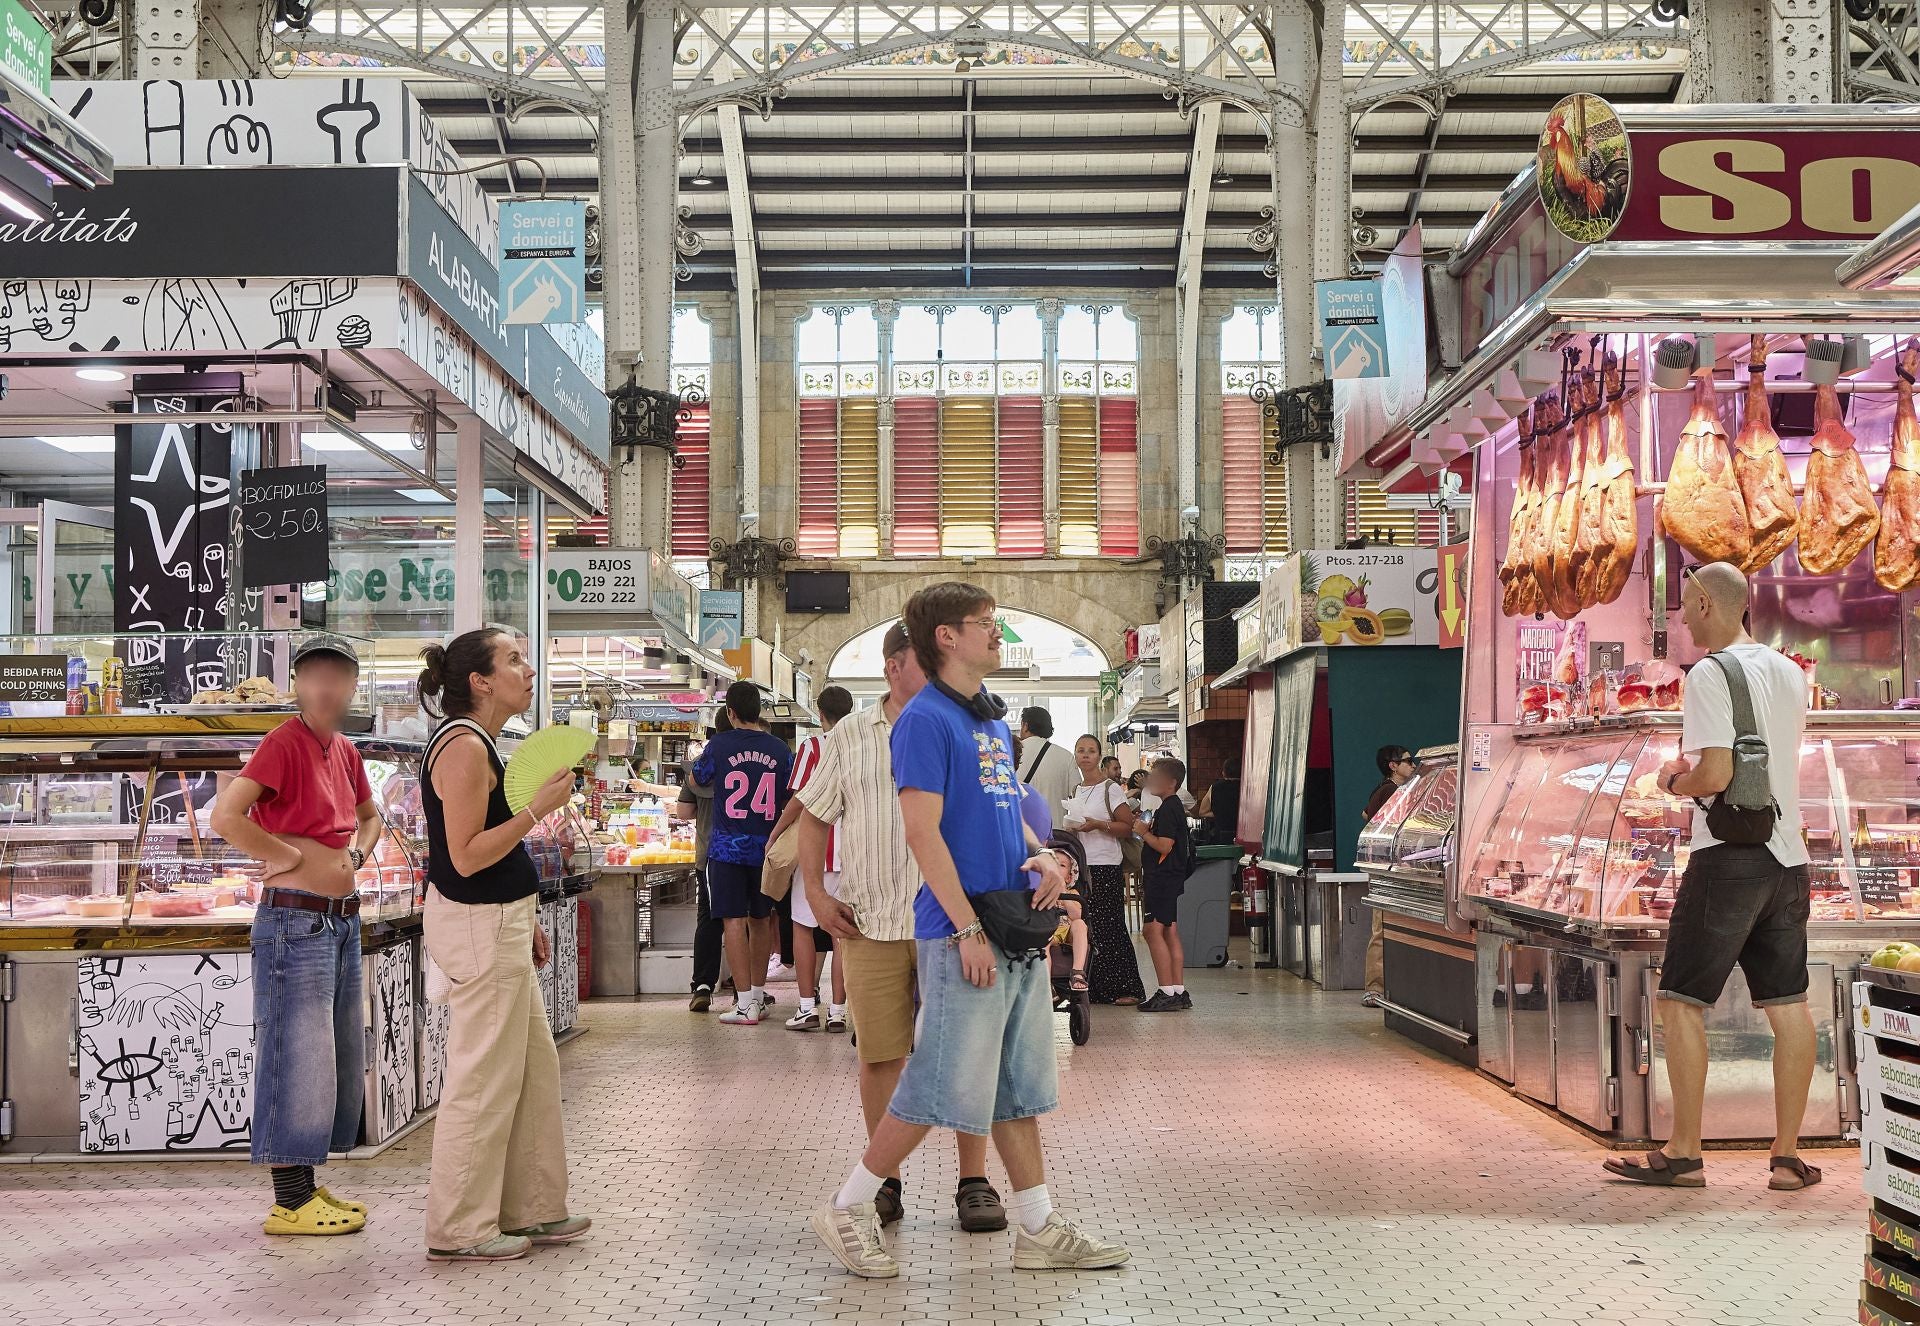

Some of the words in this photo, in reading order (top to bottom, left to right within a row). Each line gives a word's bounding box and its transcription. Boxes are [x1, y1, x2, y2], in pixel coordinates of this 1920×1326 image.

[6, 11, 37, 57] Servei
[37, 49, 44, 68] a
[512, 212, 560, 229] Servei
[565, 216, 574, 228] a
[511, 230, 575, 247] domicili
[428, 230, 509, 348] ALABARTA
[1327, 290, 1363, 303] Servei
[1367, 292, 1374, 302] a
[1328, 304, 1376, 317] domicili
[243, 480, 326, 506] BOCADILLOS
[588, 559, 632, 572] BAJOS
[1326, 555, 1355, 566] Ptos.
[1358, 555, 1404, 566] 217-218
[398, 557, 583, 602] Naaro
[583, 576, 606, 587] 219
[613, 576, 636, 587] 221
[580, 592, 605, 603] 220
[611, 592, 636, 603] 222
[702, 595, 733, 605] Servicio
[703, 605, 738, 613] domicilio
[1520, 628, 1556, 649] MARCADO
[122, 665, 160, 673] BOCADILLOS
[1520, 651, 1527, 680] A
[3, 668, 39, 677] BEBIDA
[41, 668, 63, 677] FRIA
[0, 680, 27, 690] COLD
[29, 680, 66, 690] DRINKS
[125, 678, 149, 686] QUESO
[728, 751, 777, 769] BARRIOS
[724, 770, 776, 820] 24
